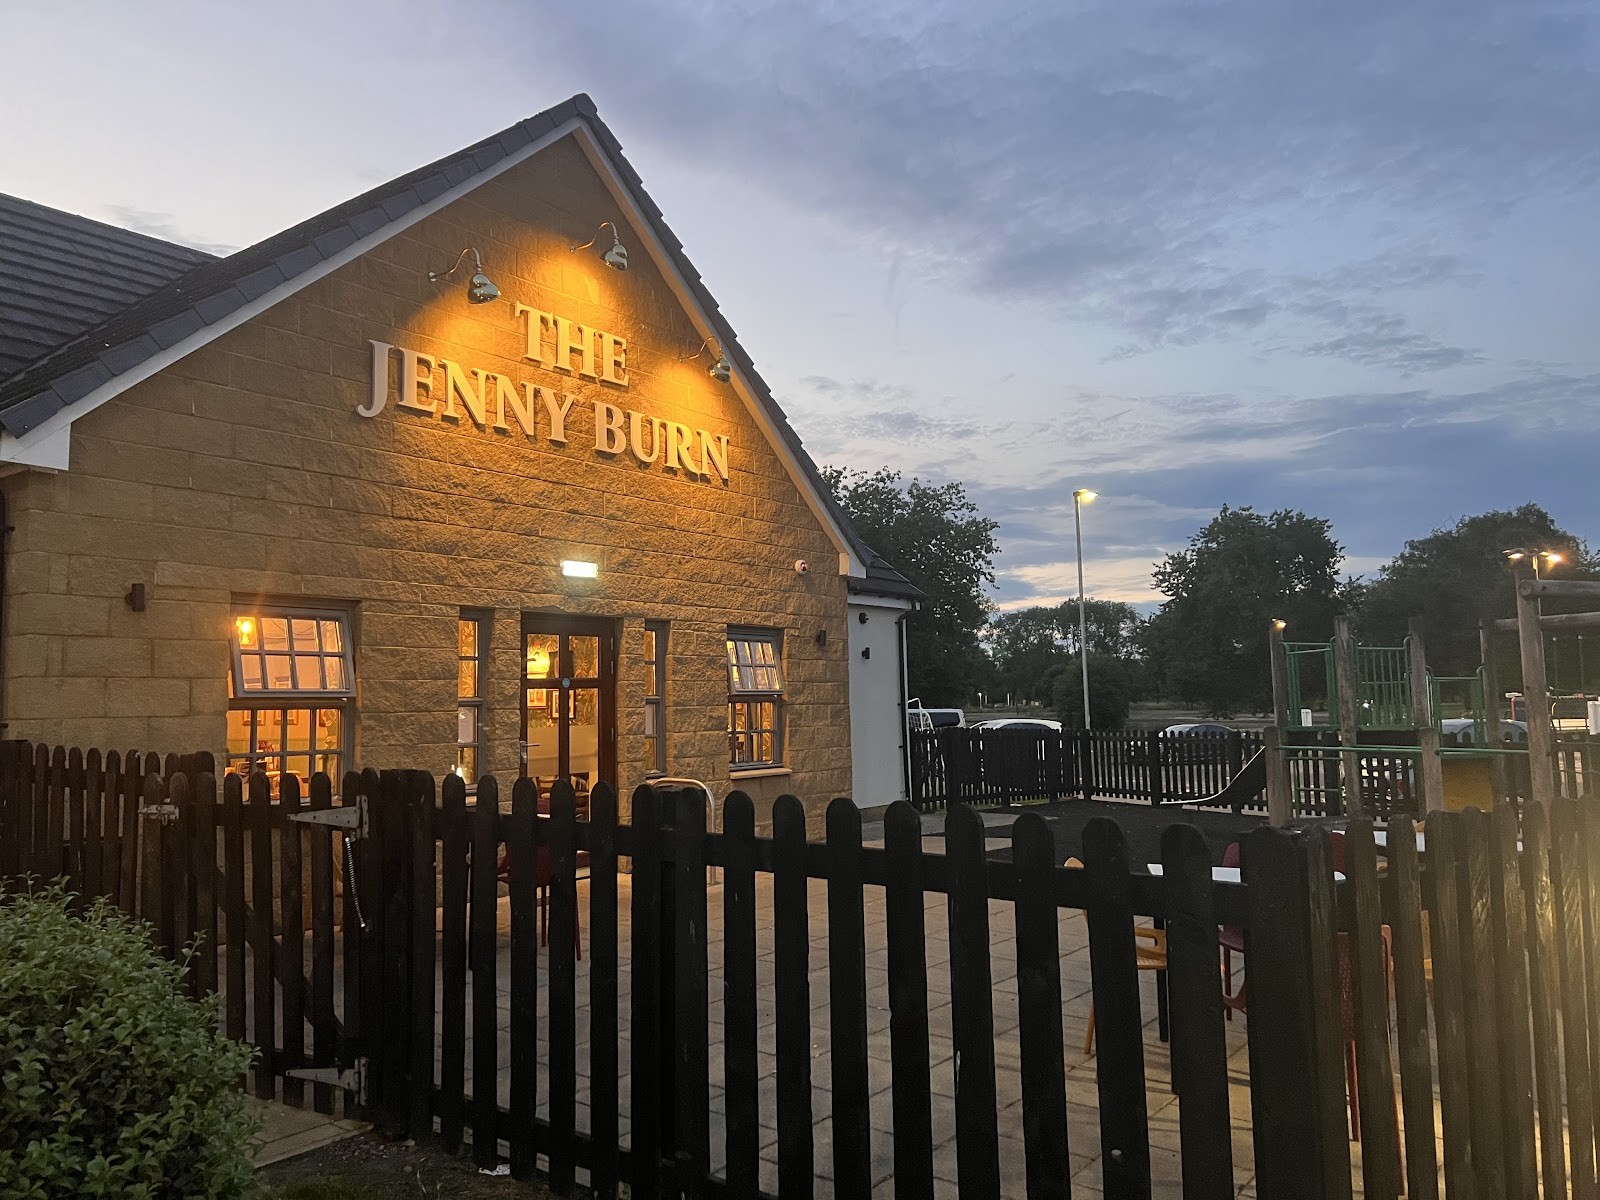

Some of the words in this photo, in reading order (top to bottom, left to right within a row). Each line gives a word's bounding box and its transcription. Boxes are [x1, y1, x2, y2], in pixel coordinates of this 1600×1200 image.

[515, 301, 629, 386] THE
[356, 339, 576, 443] JENNY
[592, 400, 730, 481] BURN
